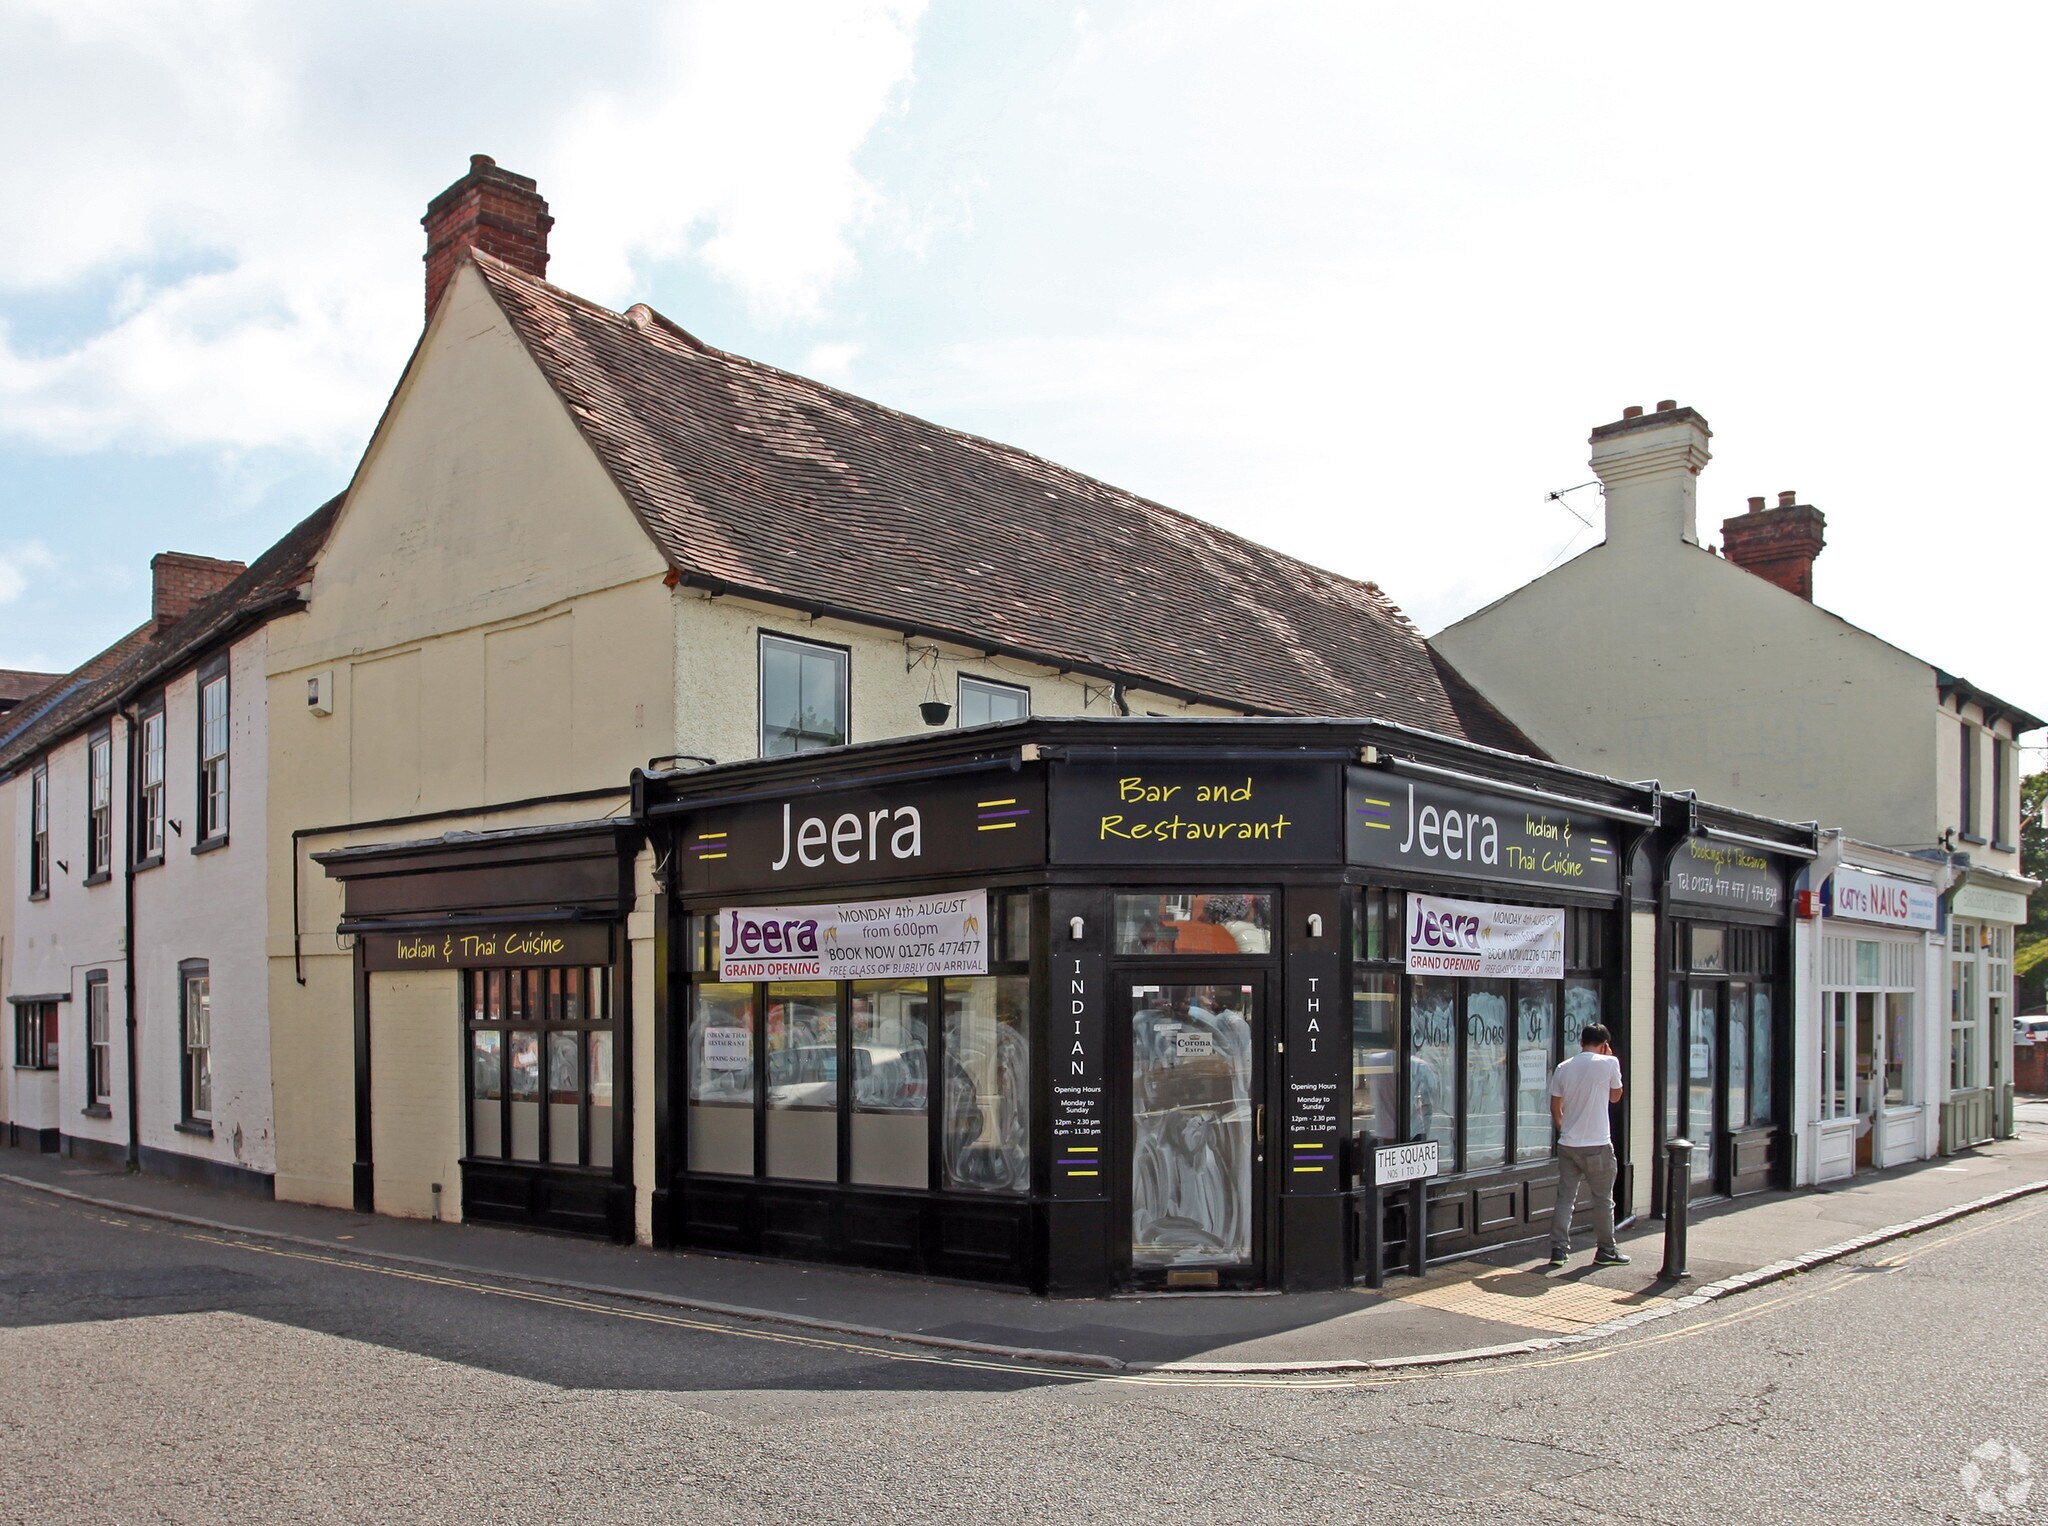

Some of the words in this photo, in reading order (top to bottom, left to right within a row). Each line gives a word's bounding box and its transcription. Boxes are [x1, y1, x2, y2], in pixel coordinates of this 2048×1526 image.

[1119, 777, 1181, 803] Bar
[1196, 777, 1252, 803] and
[1100, 814, 1292, 842] Restaurant
[1399, 783, 1498, 865] Jeera
[1526, 813, 1558, 840] Indian
[1563, 817, 1572, 848] &
[772, 803, 921, 871] Jeera
[1506, 846, 1536, 870] Thai
[1541, 851, 1583, 877] Cuisine
[1691, 838, 1725, 875] Bookings
[1691, 876, 1714, 894] 01276
[1715, 878, 1730, 897] 477
[1731, 881, 1745, 898] 477
[1751, 885, 1764, 901] 474
[838, 907, 891, 923] MONDAY
[895, 905, 914, 918] 4th
[916, 898, 966, 916] AUGUST
[1870, 883, 1908, 919] NAILS
[1411, 897, 1480, 949] Jeera
[1493, 911, 1521, 925] MONDAY
[725, 910, 819, 955] Jeera
[862, 924, 890, 939] from
[893, 922, 939, 939] 6.00pm
[1504, 930, 1520, 942] from
[397, 937, 436, 960] Indian
[442, 934, 454, 963] &
[460, 933, 496, 956] Thai
[504, 931, 565, 956] Cuisine
[828, 948, 863, 961] BOOK
[865, 945, 896, 960] NOW
[898, 943, 936, 959] 01276
[938, 940, 981, 956] 477477
[1487, 948, 1507, 960] BOOK
[1508, 948, 1523, 961] NOW
[1522, 949, 1540, 962] 01276
[725, 963, 766, 977] GRAND
[767, 961, 820, 976] OPENING
[828, 965, 848, 976] FREE
[849, 964, 876, 975] GLASS
[877, 963, 891, 974] OF
[892, 962, 925, 973] BUBBLY
[926, 961, 942, 972] ON
[943, 959, 983, 971] ARRIVAL
[1410, 955, 1441, 969] GRAND
[1442, 958, 1481, 972] OPENING
[1484, 964, 1497, 974] FREE
[1071, 959, 1085, 1075] INDIAN
[1308, 978, 1320, 1052] THAI
[1467, 1013, 1504, 1046] Does
[1527, 1010, 1542, 1043] It
[1177, 1039, 1211, 1048] Corona
[1054, 1086, 1081, 1094] Opening
[1291, 1081, 1317, 1091] Opening
[1318, 1081, 1337, 1090] Hours
[1066, 1107, 1090, 1115] Sunday
[1297, 1096, 1321, 1104] Monday
[1302, 1103, 1325, 1111] Sunday
[1291, 1115, 1308, 1123] 12pm
[1378, 1151, 1396, 1168] THE
[1400, 1145, 1436, 1165] SQUARE
[1406, 1166, 1415, 1176] TO
